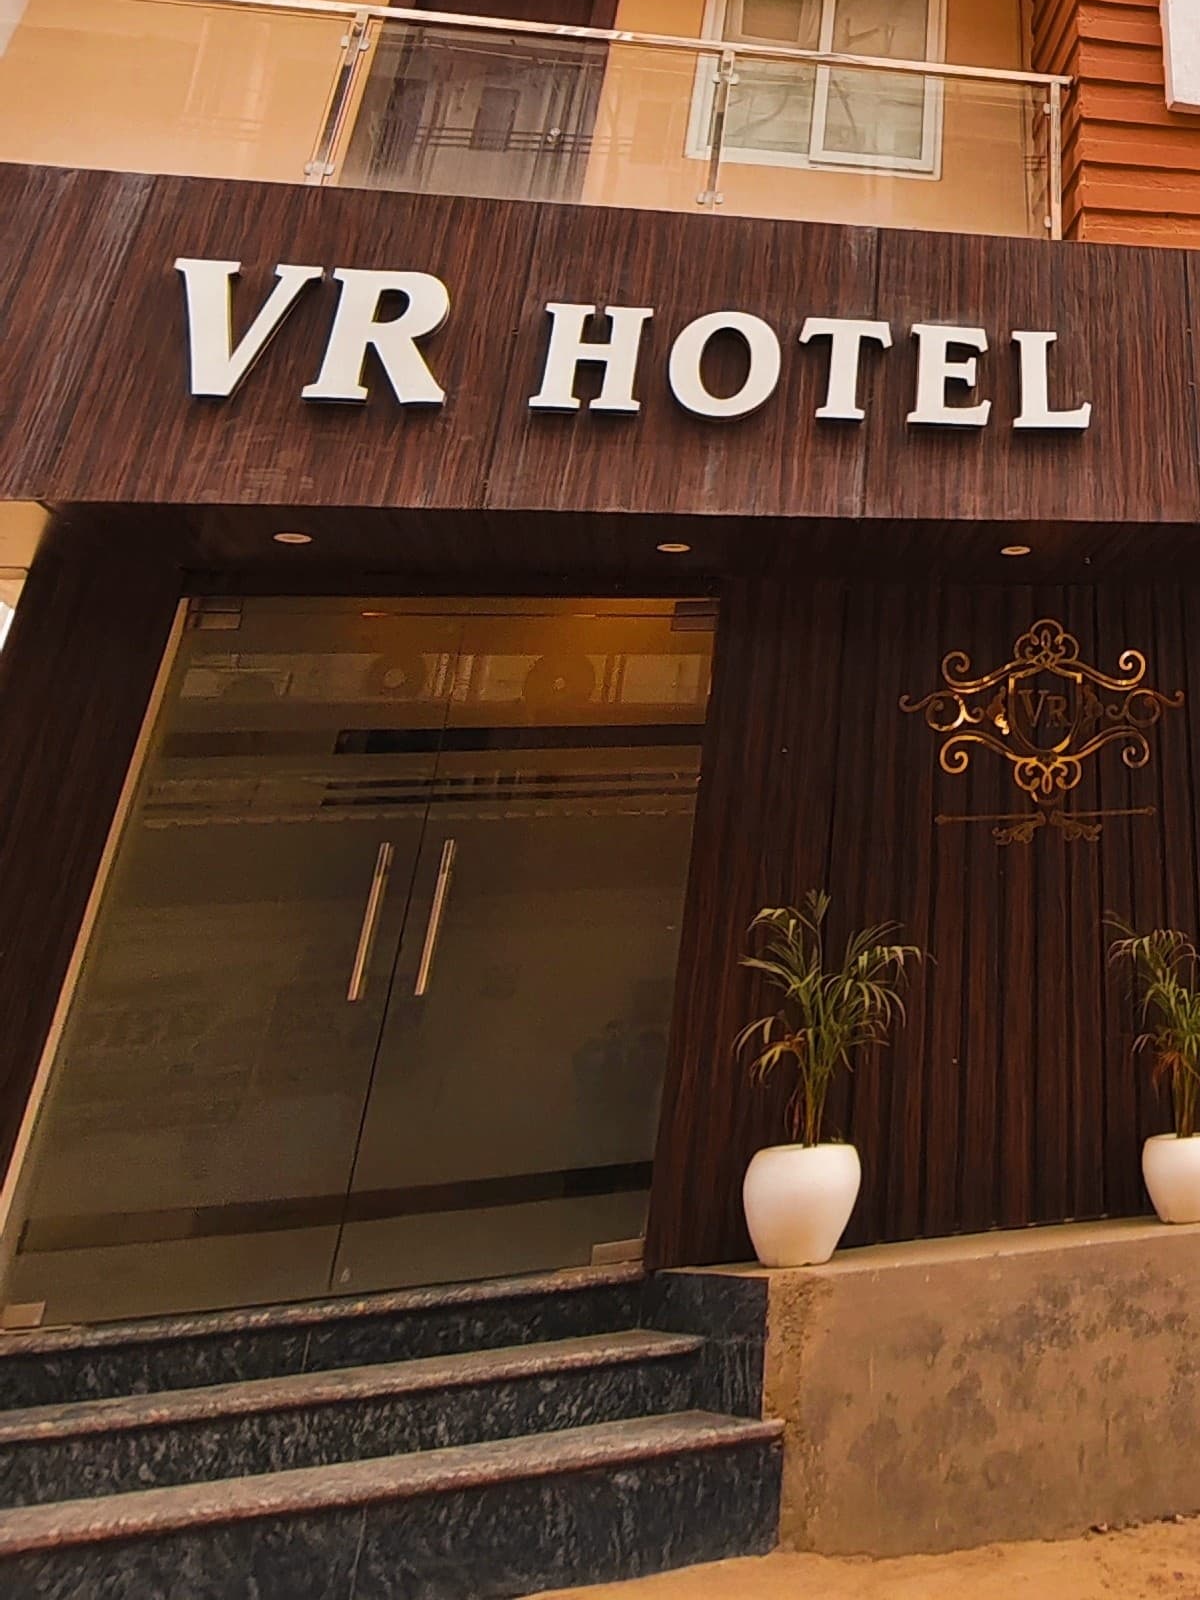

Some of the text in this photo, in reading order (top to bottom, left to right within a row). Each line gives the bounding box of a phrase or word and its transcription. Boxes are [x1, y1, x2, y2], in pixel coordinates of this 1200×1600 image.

[173, 256, 1092, 430] VR HOTEL
[1018, 689, 1072, 729] VR
